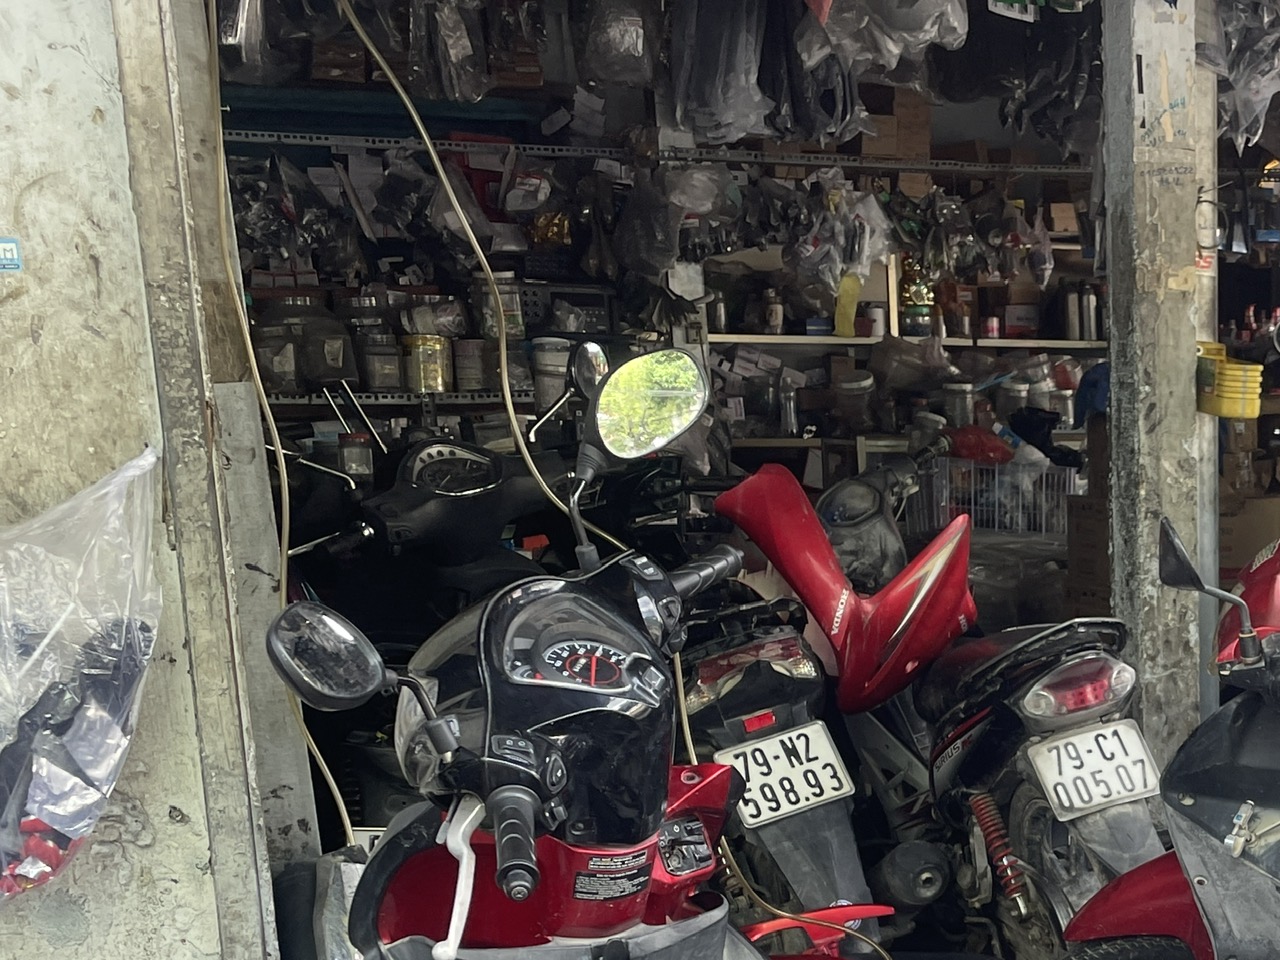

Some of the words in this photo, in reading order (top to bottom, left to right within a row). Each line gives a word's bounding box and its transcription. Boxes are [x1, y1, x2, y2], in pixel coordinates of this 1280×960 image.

[831, 588, 850, 635] HONDA
[733, 733, 819, 783] 79-N2
[934, 741, 961, 773] SIRIUS
[1047, 729, 1130, 776] 79-C1
[743, 762, 844, 819] 598.93
[1053, 758, 1148, 812] 005.07
